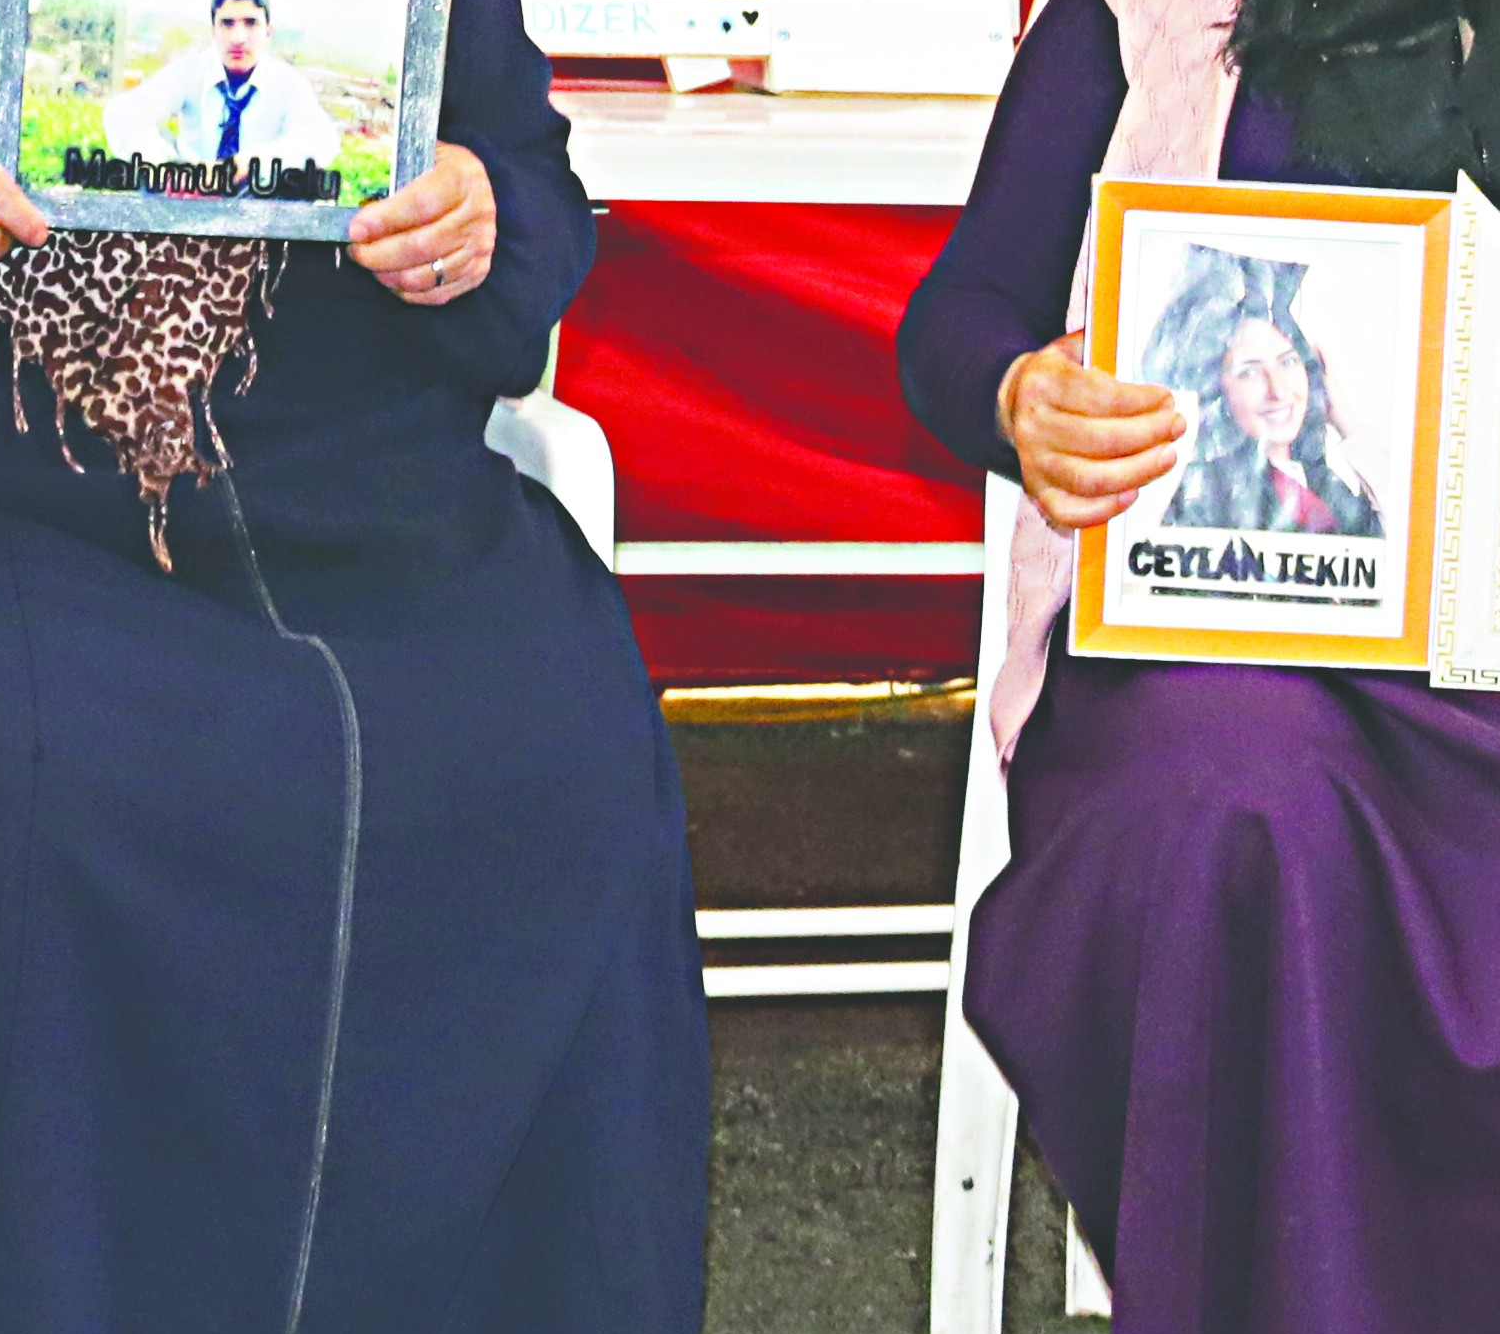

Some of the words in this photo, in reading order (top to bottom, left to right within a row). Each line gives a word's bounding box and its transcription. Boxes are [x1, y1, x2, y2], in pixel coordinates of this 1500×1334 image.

[530, 0, 658, 36] DIZER
[63, 147, 238, 196] Mahmut
[249, 156, 341, 200] Uslu
